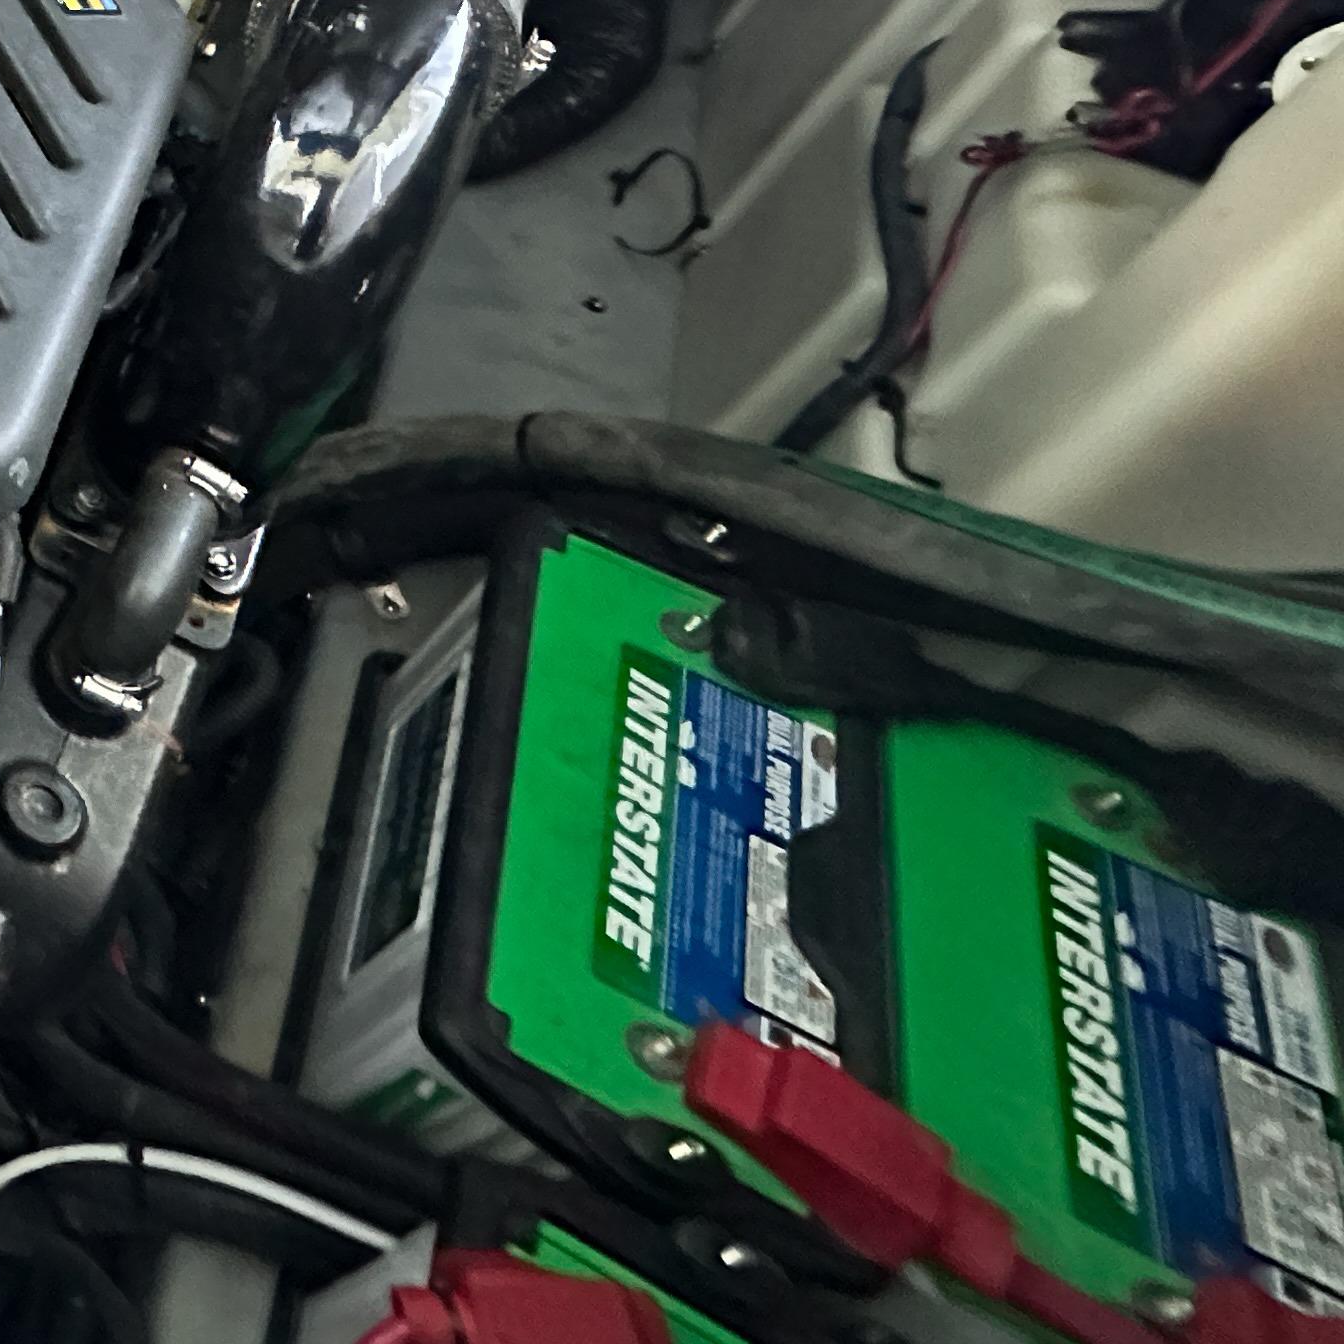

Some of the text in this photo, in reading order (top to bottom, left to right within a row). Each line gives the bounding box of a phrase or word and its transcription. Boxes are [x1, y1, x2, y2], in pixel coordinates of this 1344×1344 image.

[606, 667, 671, 961] INTERSTATE
[763, 755, 790, 840] PURPOSE
[1047, 851, 1134, 1197] INTERSTATE
